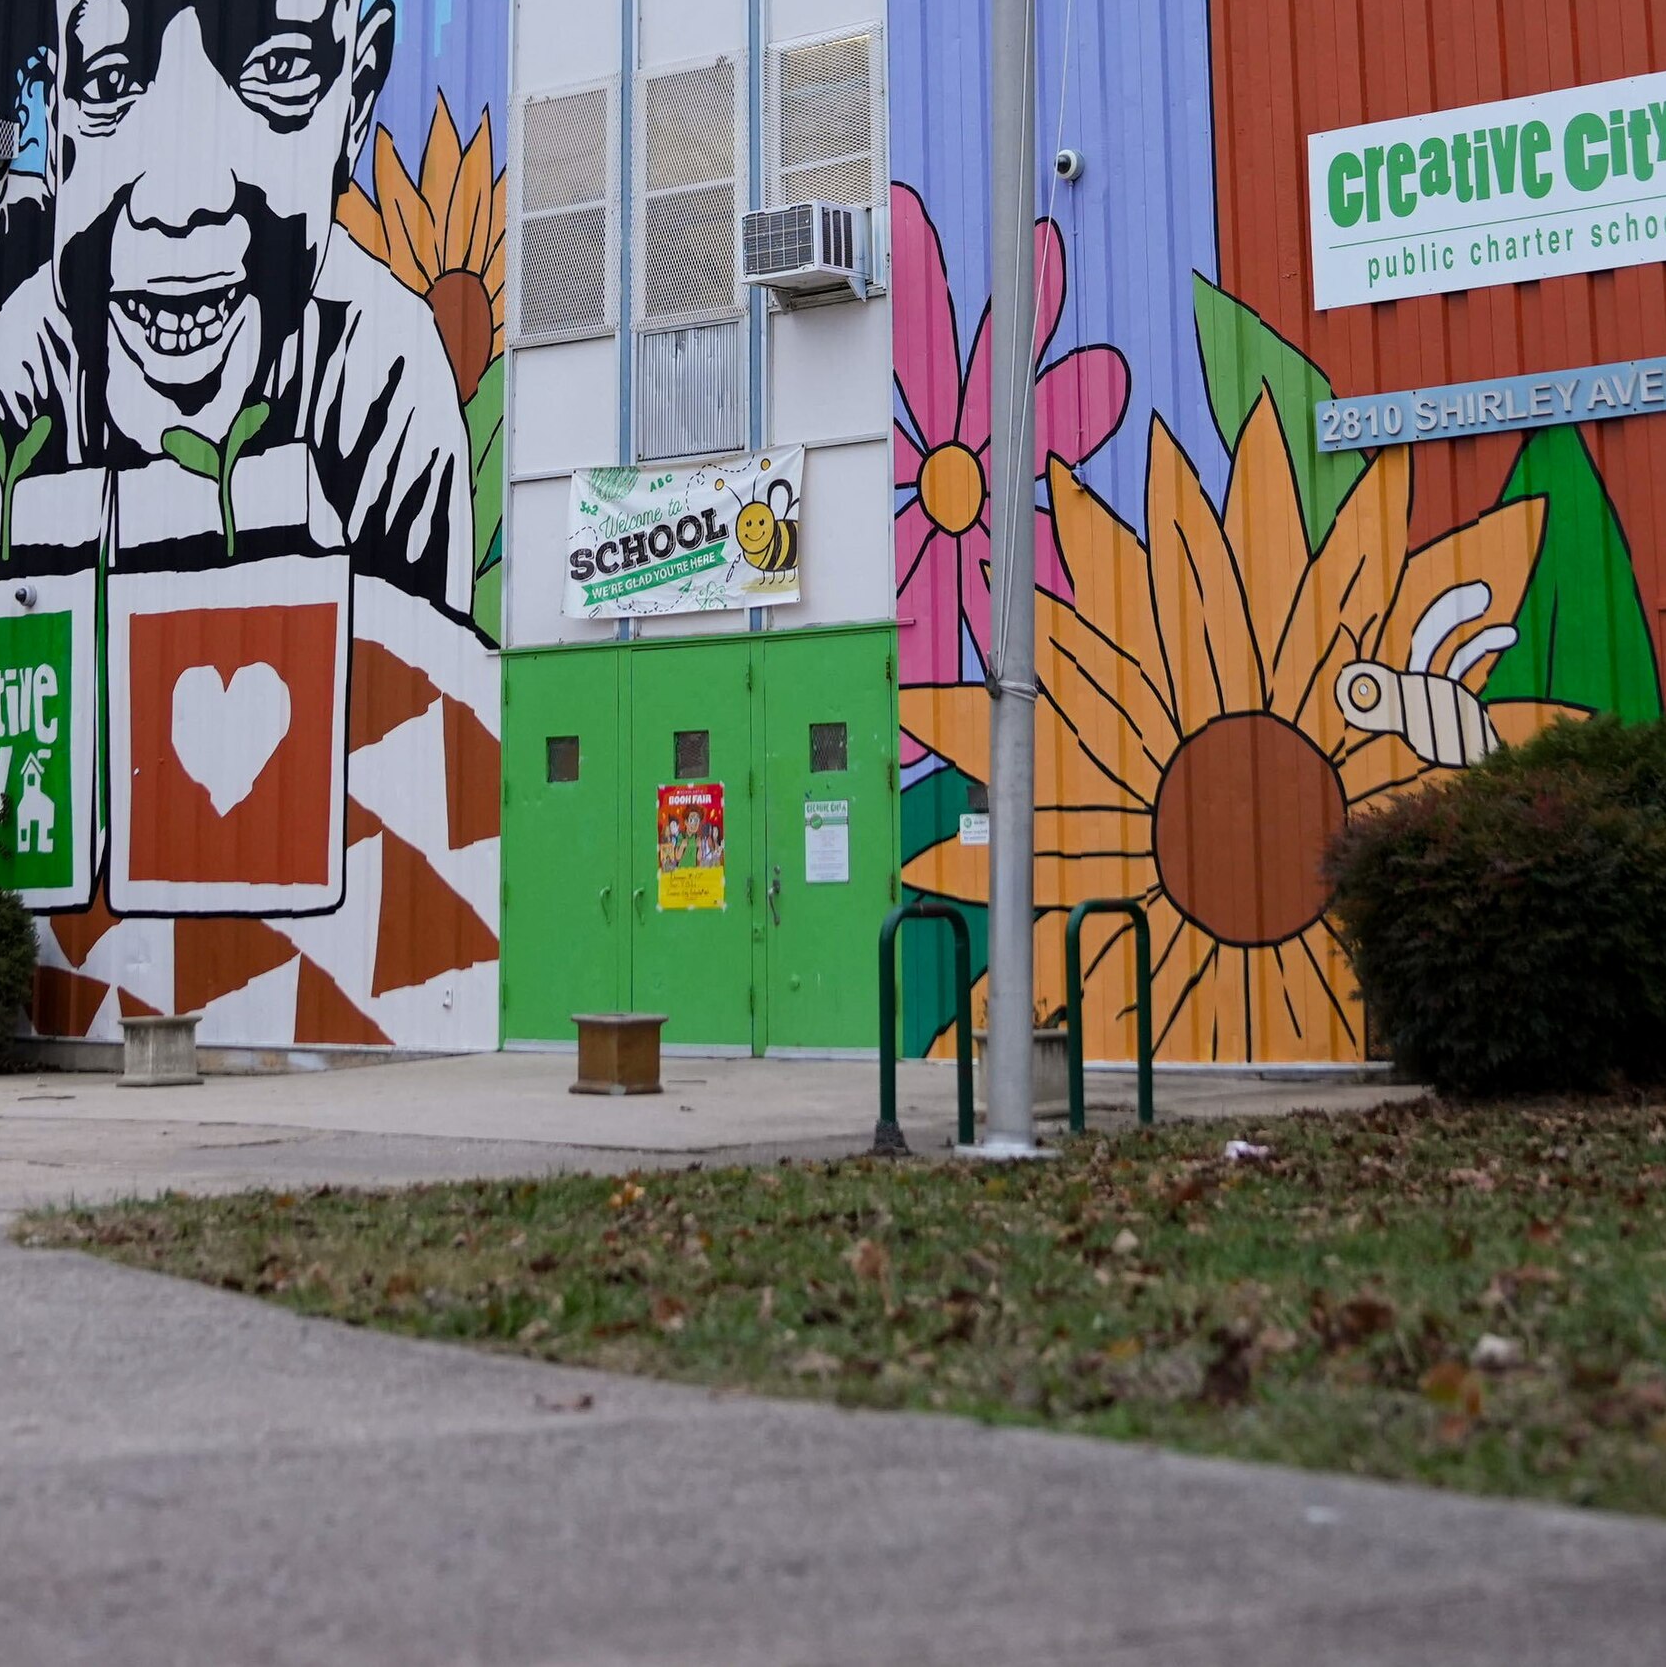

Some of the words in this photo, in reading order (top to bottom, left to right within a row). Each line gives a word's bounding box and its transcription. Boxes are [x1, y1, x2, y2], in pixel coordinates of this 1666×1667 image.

[1367, 242, 1454, 288] public
[1469, 224, 1574, 266] charter
[1321, 405, 1403, 444] 2810
[1414, 378, 1581, 433] SHIRLEY
[569, 507, 730, 583] SCHOOL
[599, 505, 663, 539] Welcome
[668, 497, 683, 518] to
[591, 583, 624, 599] WE'RE
[625, 571, 653, 590] GLAD
[653, 560, 689, 582] YOU'RE
[690, 551, 716, 569] HERE
[692, 794, 712, 804] FAIR
